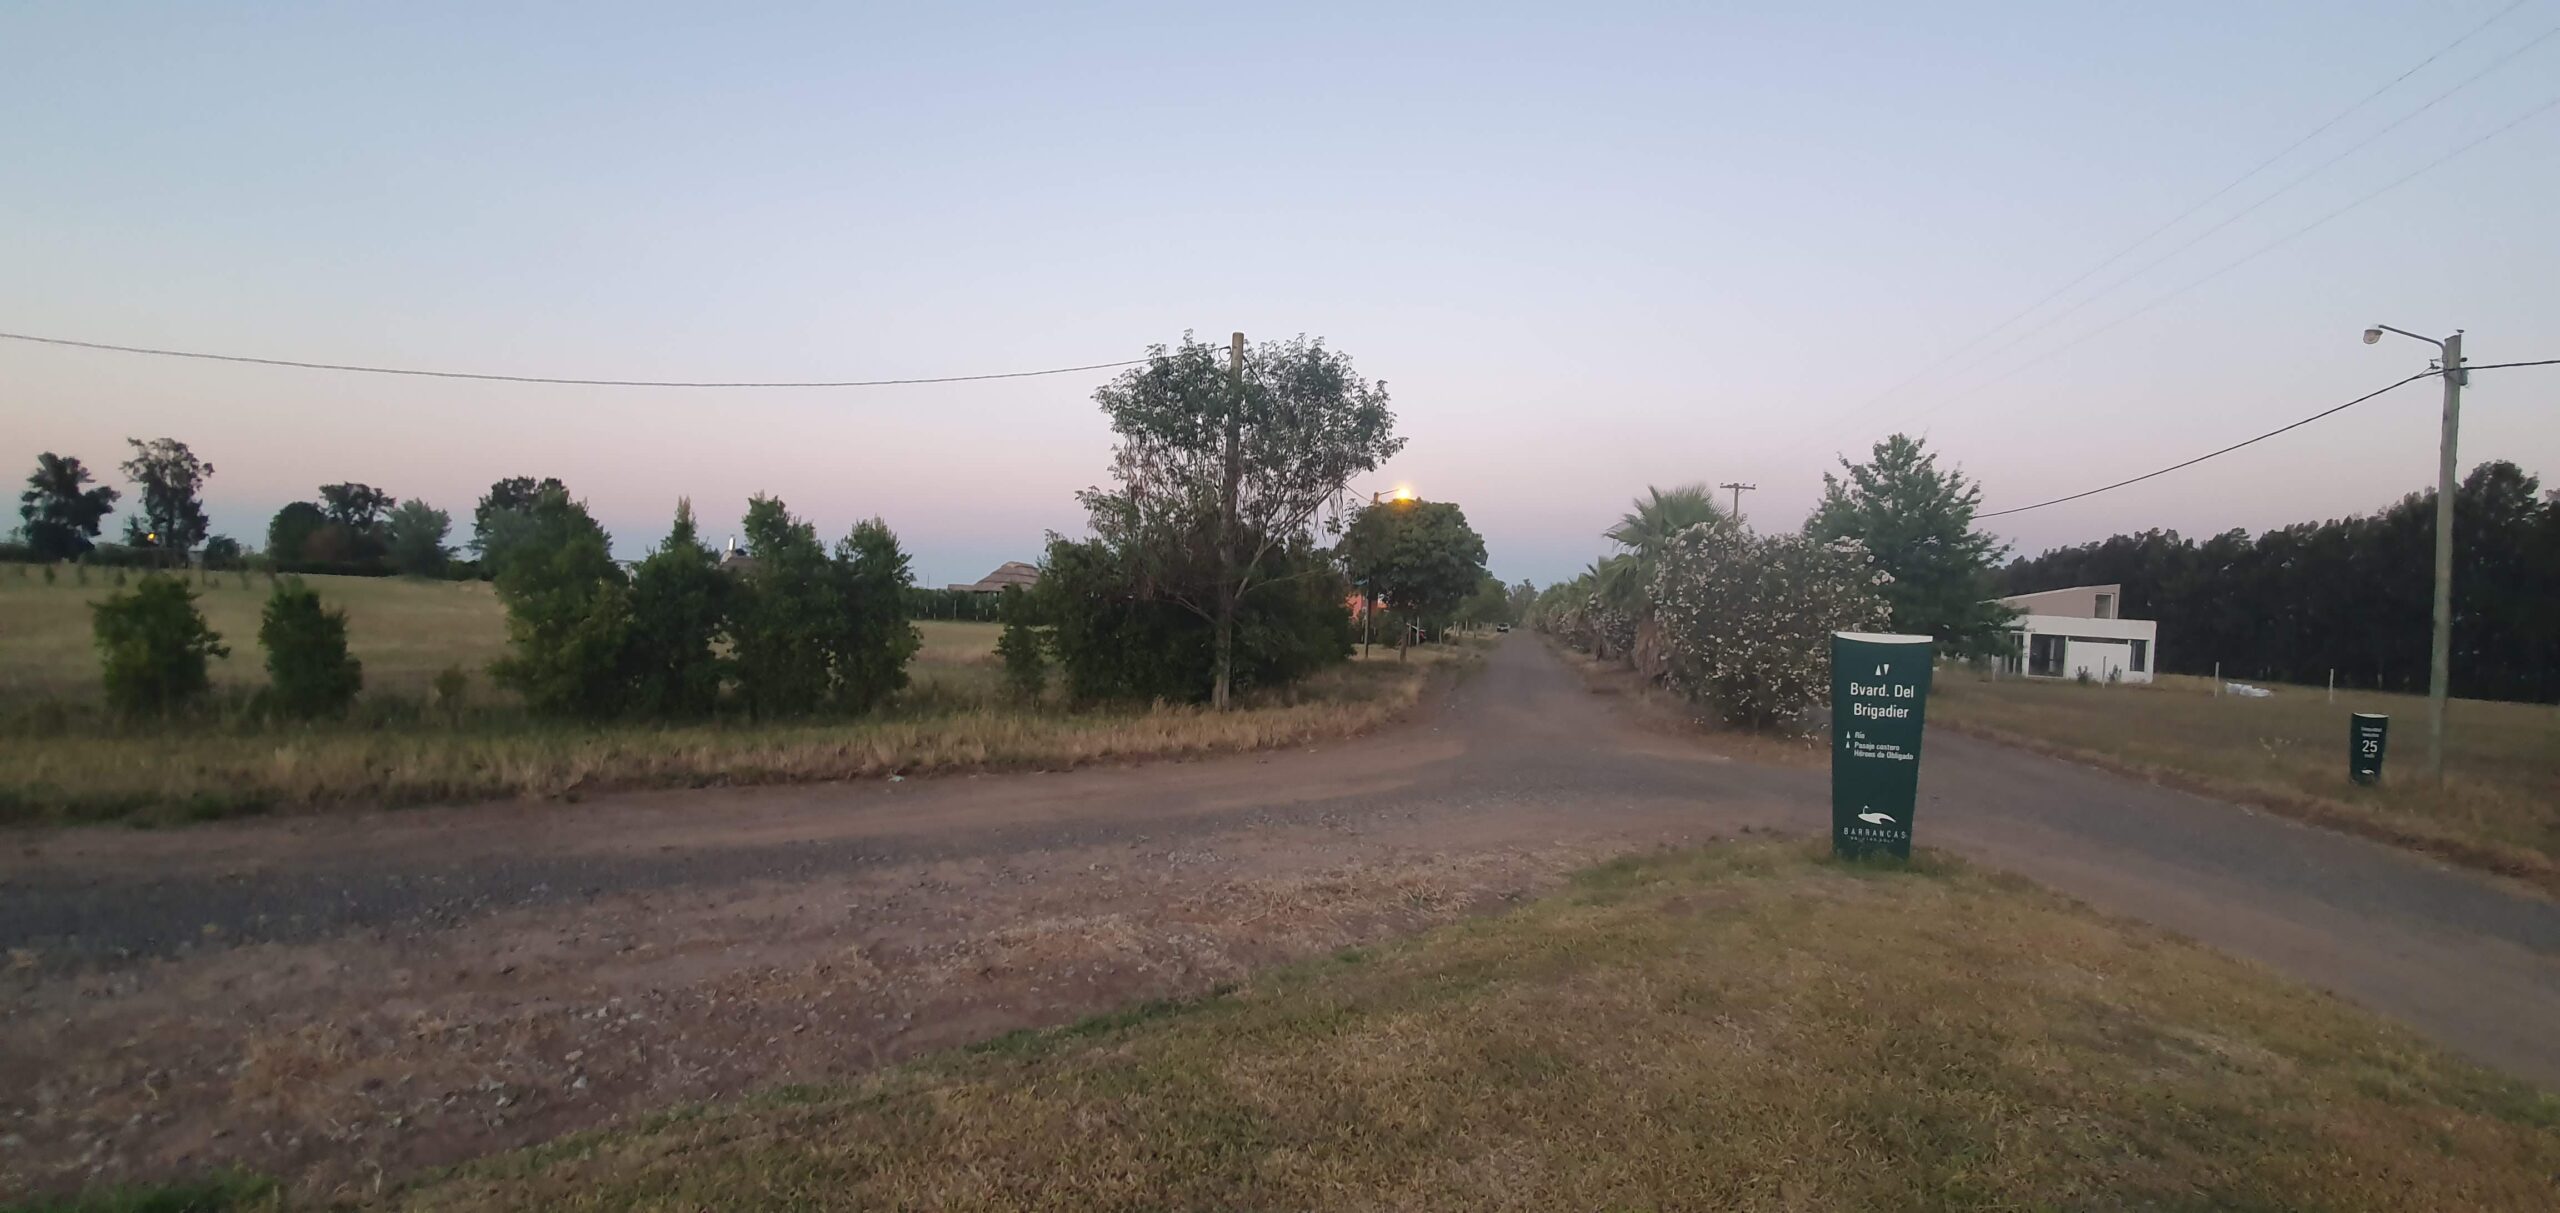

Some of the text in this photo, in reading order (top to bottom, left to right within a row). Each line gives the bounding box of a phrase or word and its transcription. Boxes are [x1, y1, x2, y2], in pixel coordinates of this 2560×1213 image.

[1850, 682, 1914, 698] Bvard. Del
[1853, 702, 1909, 720] Brigadier
[2362, 739, 2378, 753] 25
[1843, 827, 1906, 840] BARRANCAS
